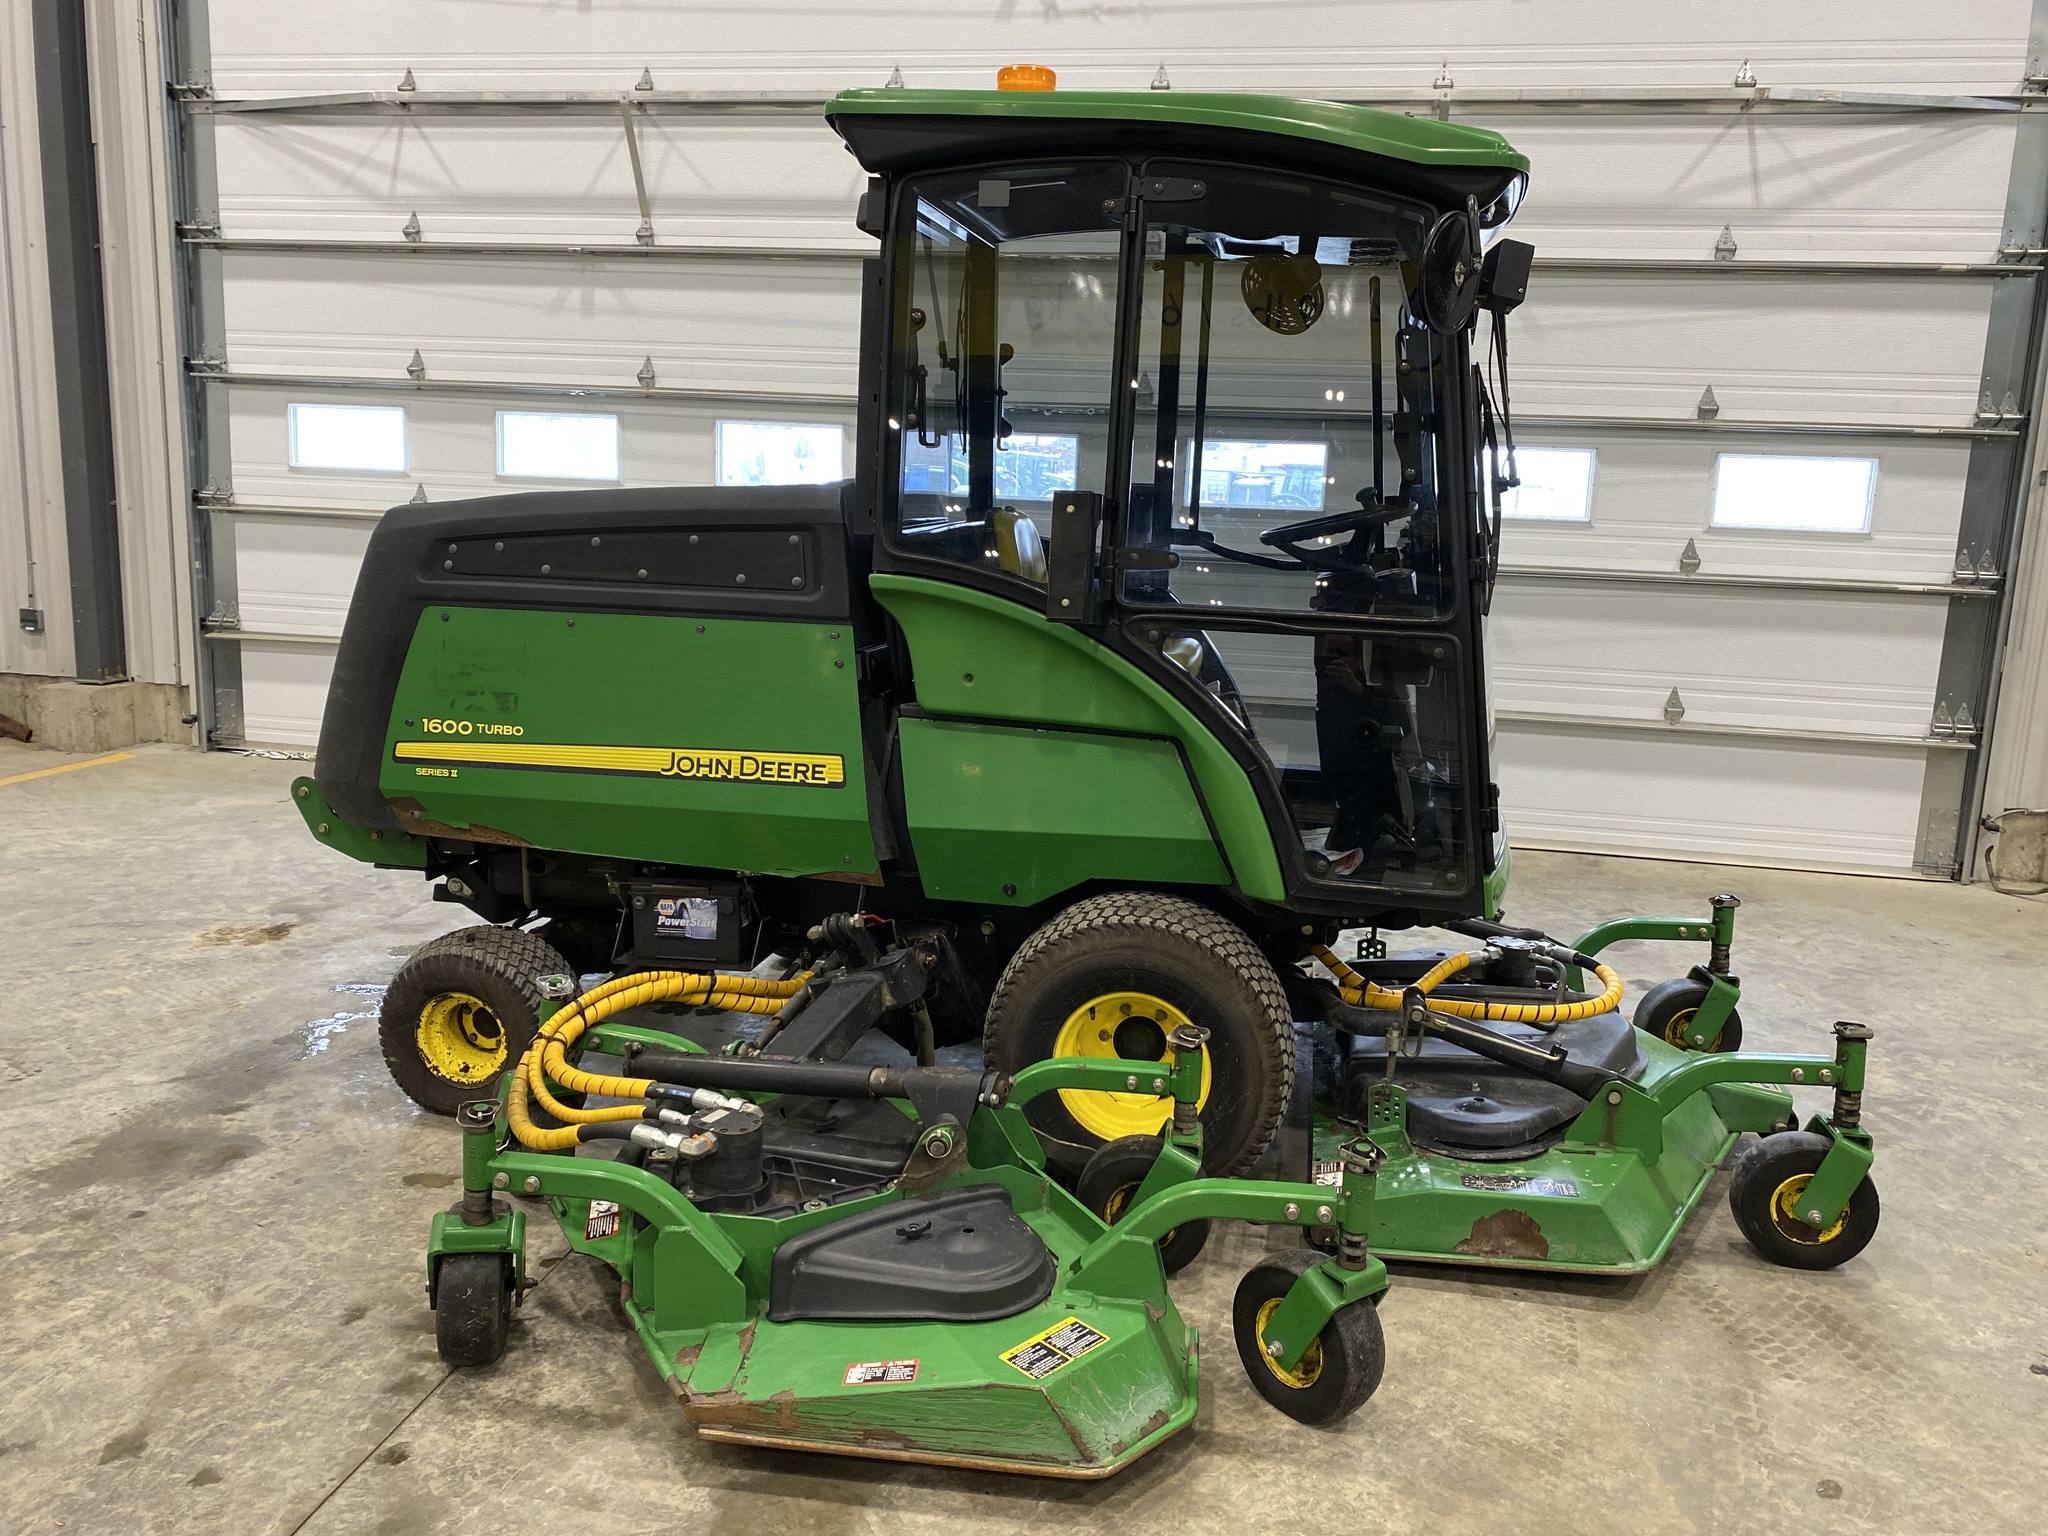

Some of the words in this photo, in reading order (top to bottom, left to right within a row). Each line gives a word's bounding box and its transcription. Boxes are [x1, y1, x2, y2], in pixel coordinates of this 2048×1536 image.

[422, 718, 473, 736] 1600
[476, 723, 524, 736] TURBO
[415, 767, 449, 777] SERIES
[451, 769, 458, 778] II
[661, 752, 733, 778] JOHN
[739, 756, 828, 783] DEERE
[660, 903, 674, 911] NAPA
[657, 915, 716, 928] PowerStart
